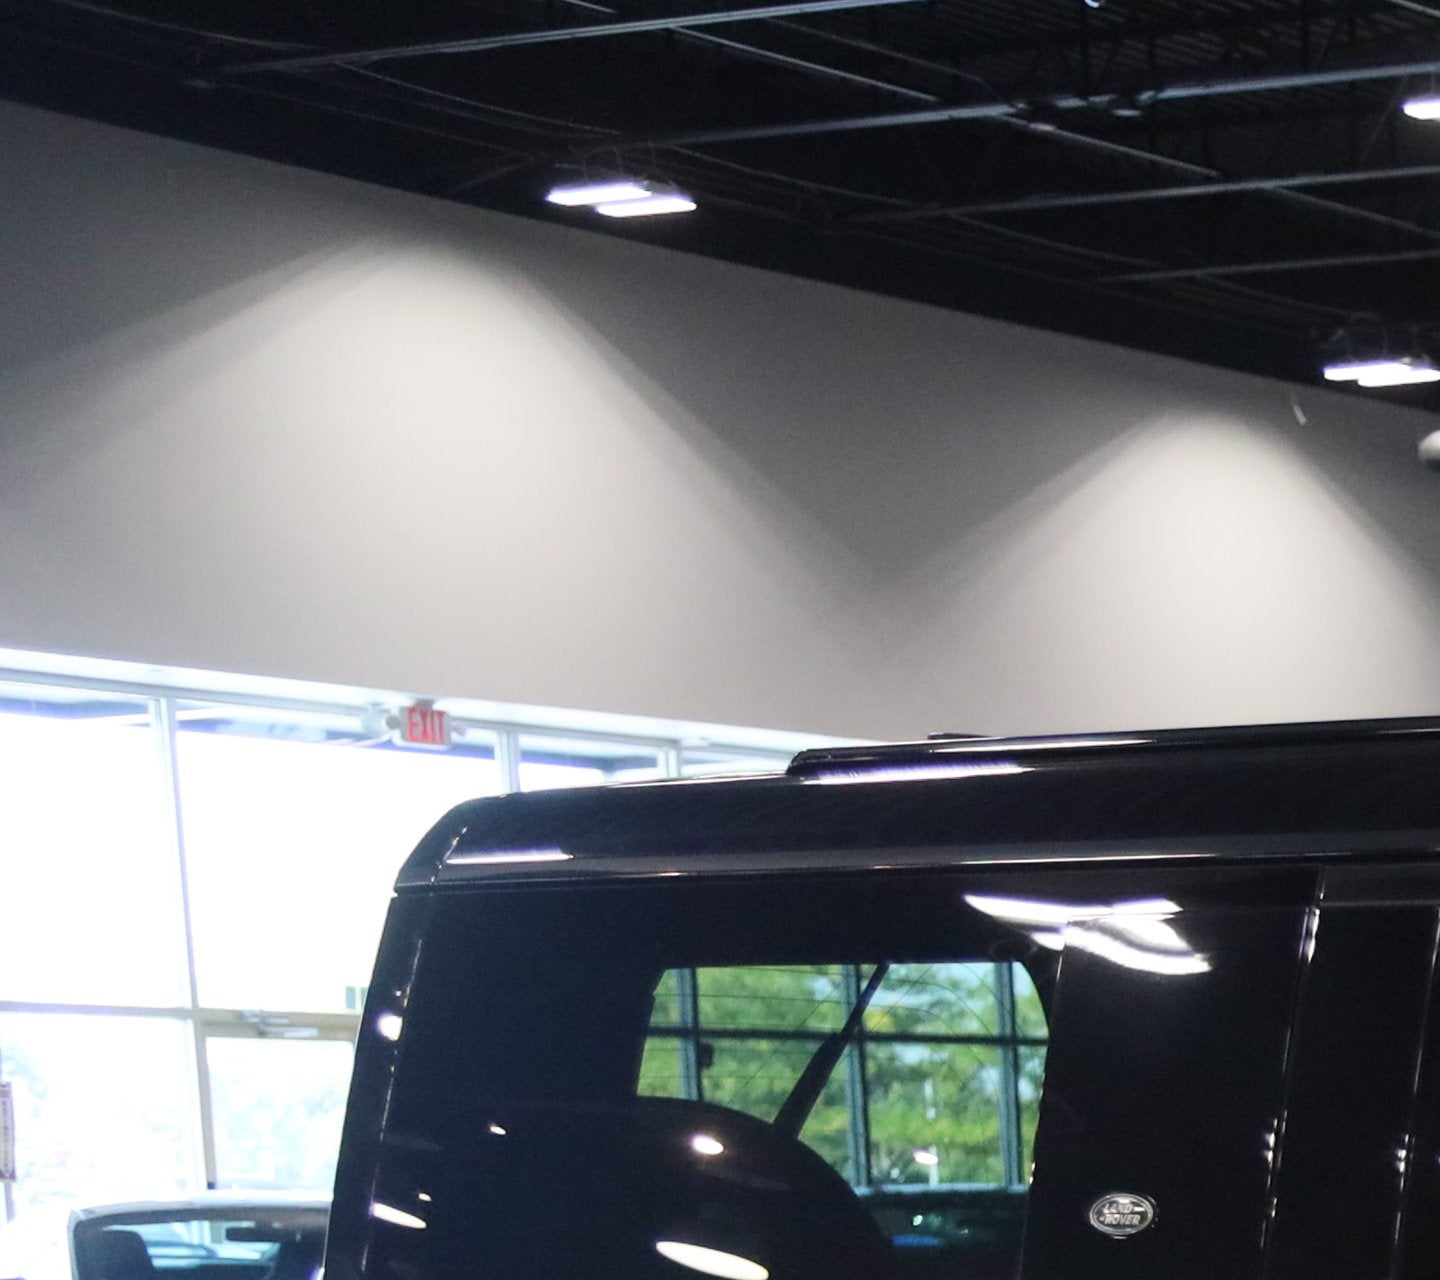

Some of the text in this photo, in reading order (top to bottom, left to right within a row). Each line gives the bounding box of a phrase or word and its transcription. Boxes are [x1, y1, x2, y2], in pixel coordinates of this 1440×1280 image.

[407, 707, 446, 746] EXIT
[1103, 1203, 1133, 1214] LAND
[1104, 1213, 1141, 1225] ROVER
